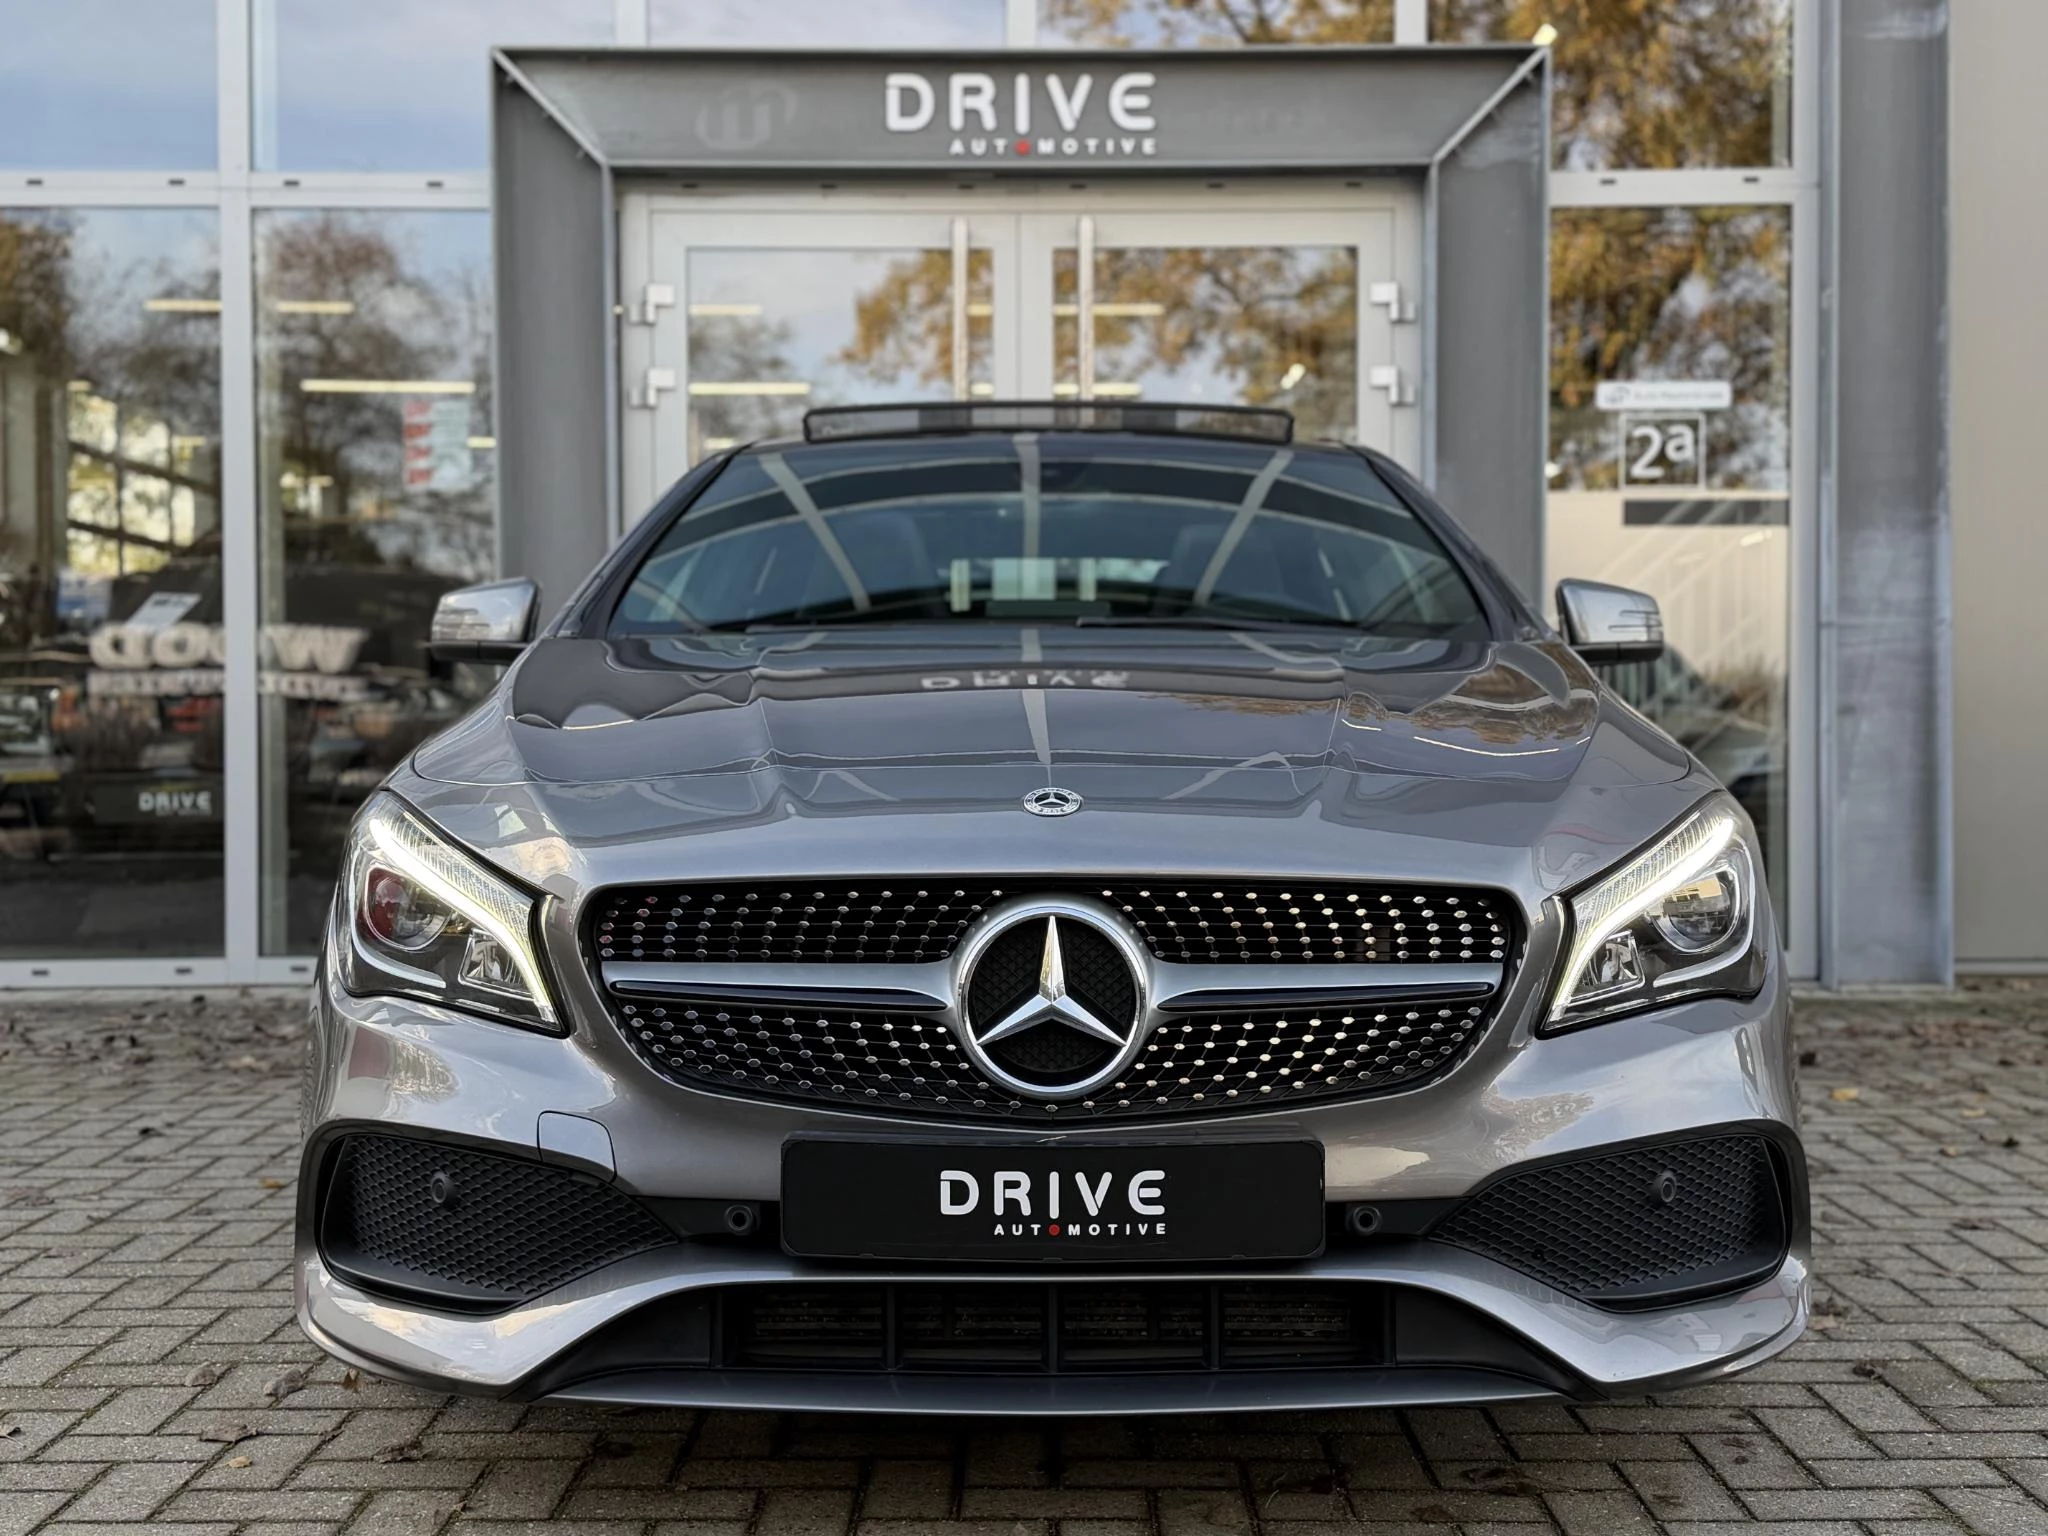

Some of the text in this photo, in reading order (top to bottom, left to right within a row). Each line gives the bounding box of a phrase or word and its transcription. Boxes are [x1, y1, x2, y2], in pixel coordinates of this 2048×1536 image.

[885, 72, 1157, 135] DRIVE
[949, 137, 1158, 156] AUTOMOTIVE
[1629, 422, 1696, 480] 2a
[138, 791, 212, 812] DRIVE
[940, 1169, 1166, 1219] DRIVE
[993, 1222, 1167, 1237] AUTOMOTIVE
